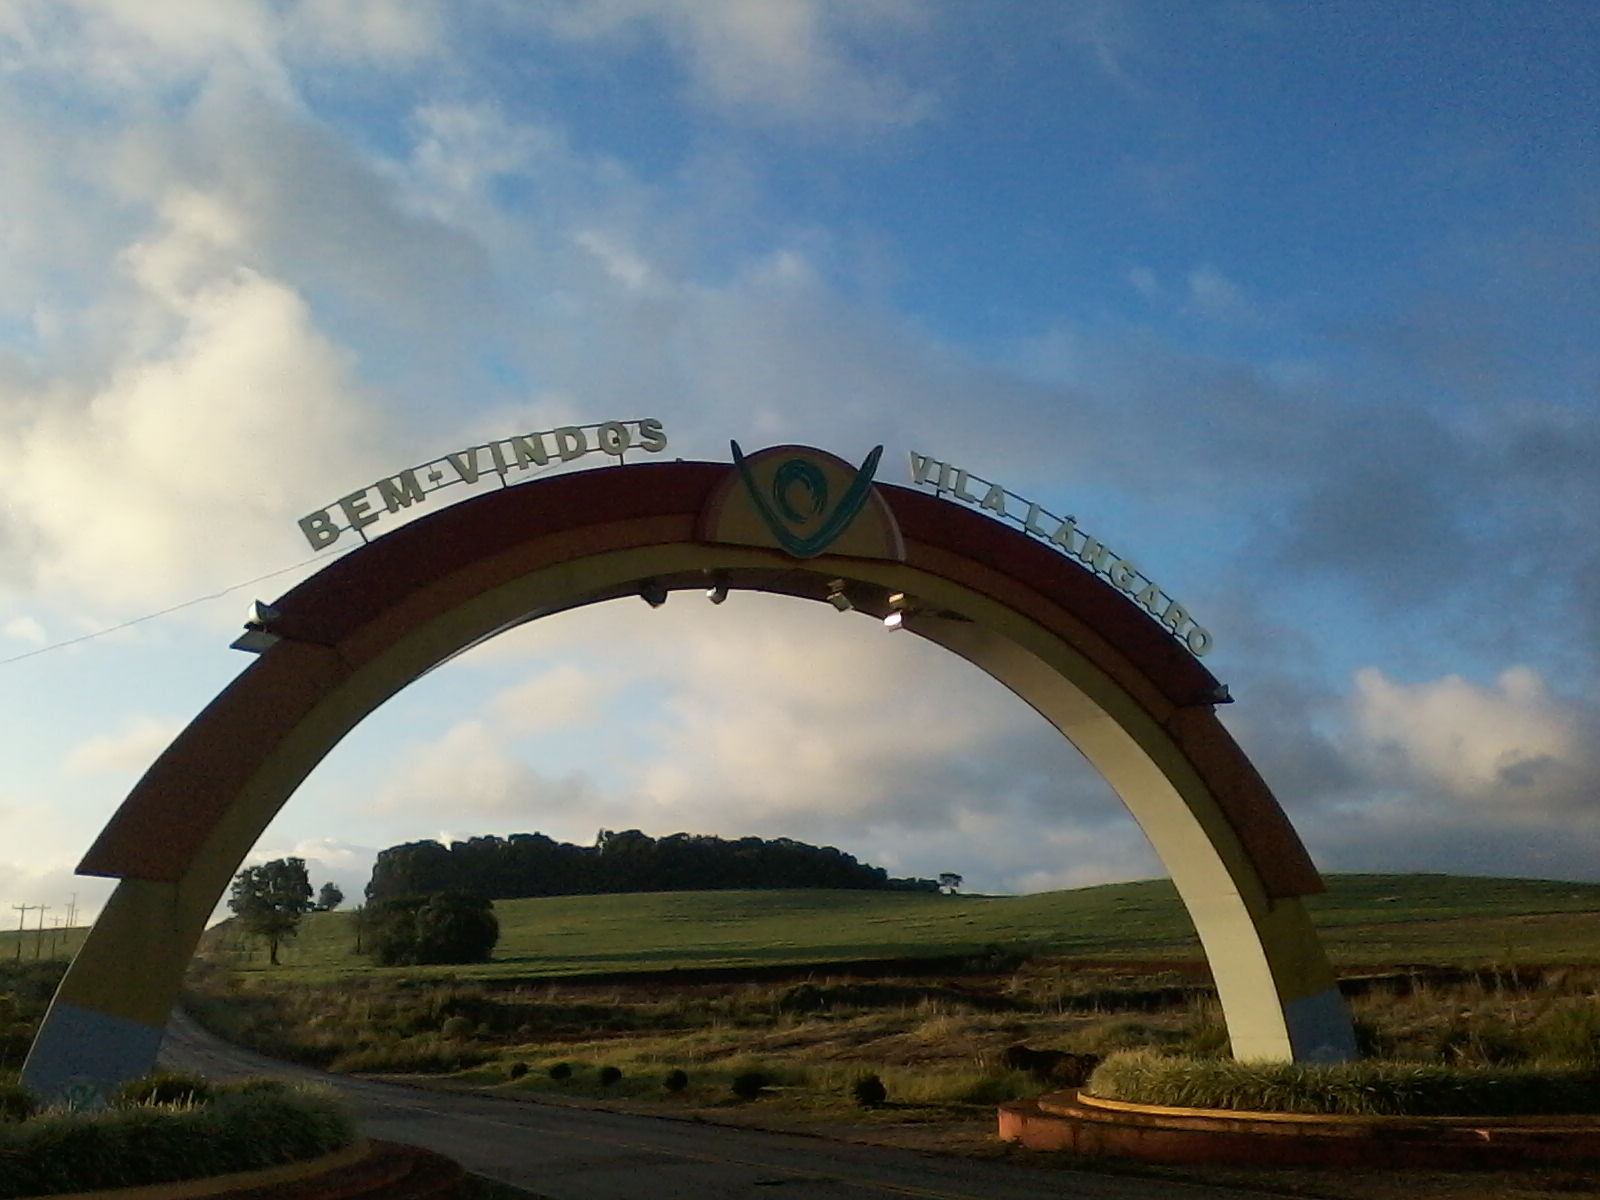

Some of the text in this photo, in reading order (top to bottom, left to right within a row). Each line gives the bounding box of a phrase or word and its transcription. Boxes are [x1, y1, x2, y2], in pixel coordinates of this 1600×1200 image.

[297, 418, 667, 551] BEM-VINDOS
[908, 451, 1214, 657] VILA LÂNGARO
